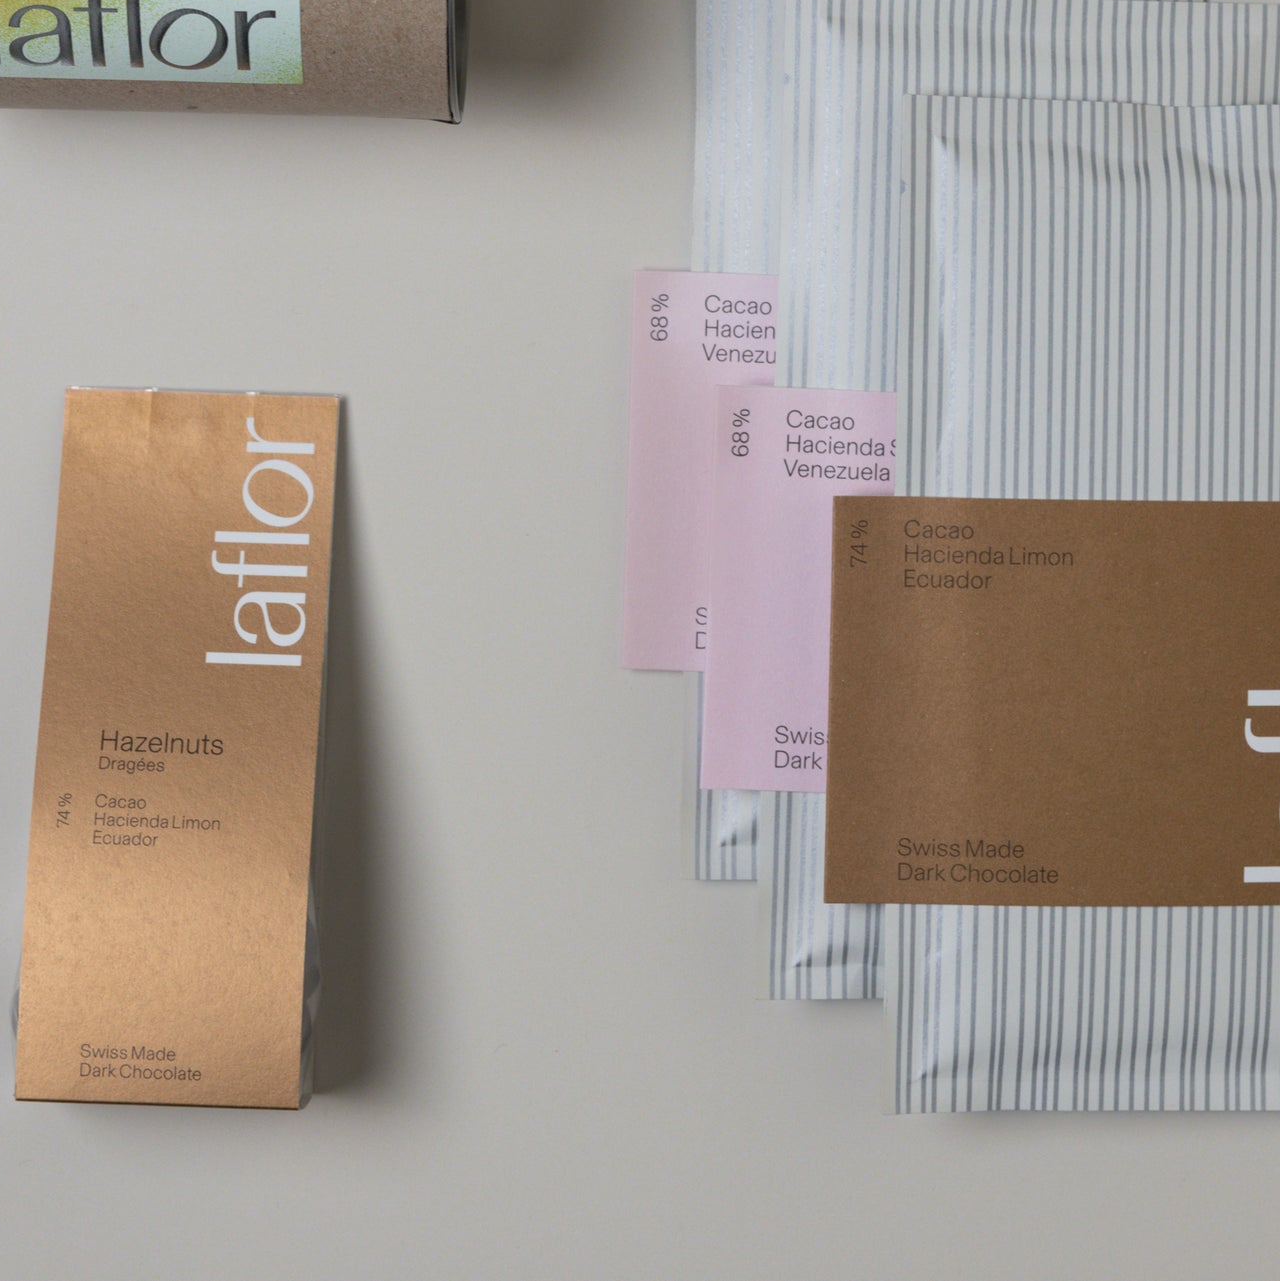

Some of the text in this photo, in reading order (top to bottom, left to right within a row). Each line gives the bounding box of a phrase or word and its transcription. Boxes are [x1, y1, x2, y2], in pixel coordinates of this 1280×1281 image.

[704, 295, 773, 316] Cacao
[786, 410, 855, 431] Cacao
[786, 435, 885, 457] Hacienda
[784, 459, 891, 482] Venezuela
[903, 520, 974, 540] Cacao
[205, 417, 316, 667] laflor
[903, 544, 1075, 566] Hacienda Limon
[903, 569, 993, 589] Ecuador
[99, 730, 224, 756] Hazelnuts
[774, 725, 829, 746] Swis
[98, 756, 165, 774] Dragées
[774, 750, 823, 770] Dark
[94, 794, 147, 810] Cacao
[93, 813, 221, 831] Hacienda Limon
[92, 831, 158, 847] Ecuador
[897, 837, 1025, 858] Swiss Made
[898, 863, 1059, 884] Dark Chocolate
[80, 1044, 176, 1062] Swiss Made
[79, 1063, 202, 1082] Dark Chocolate
